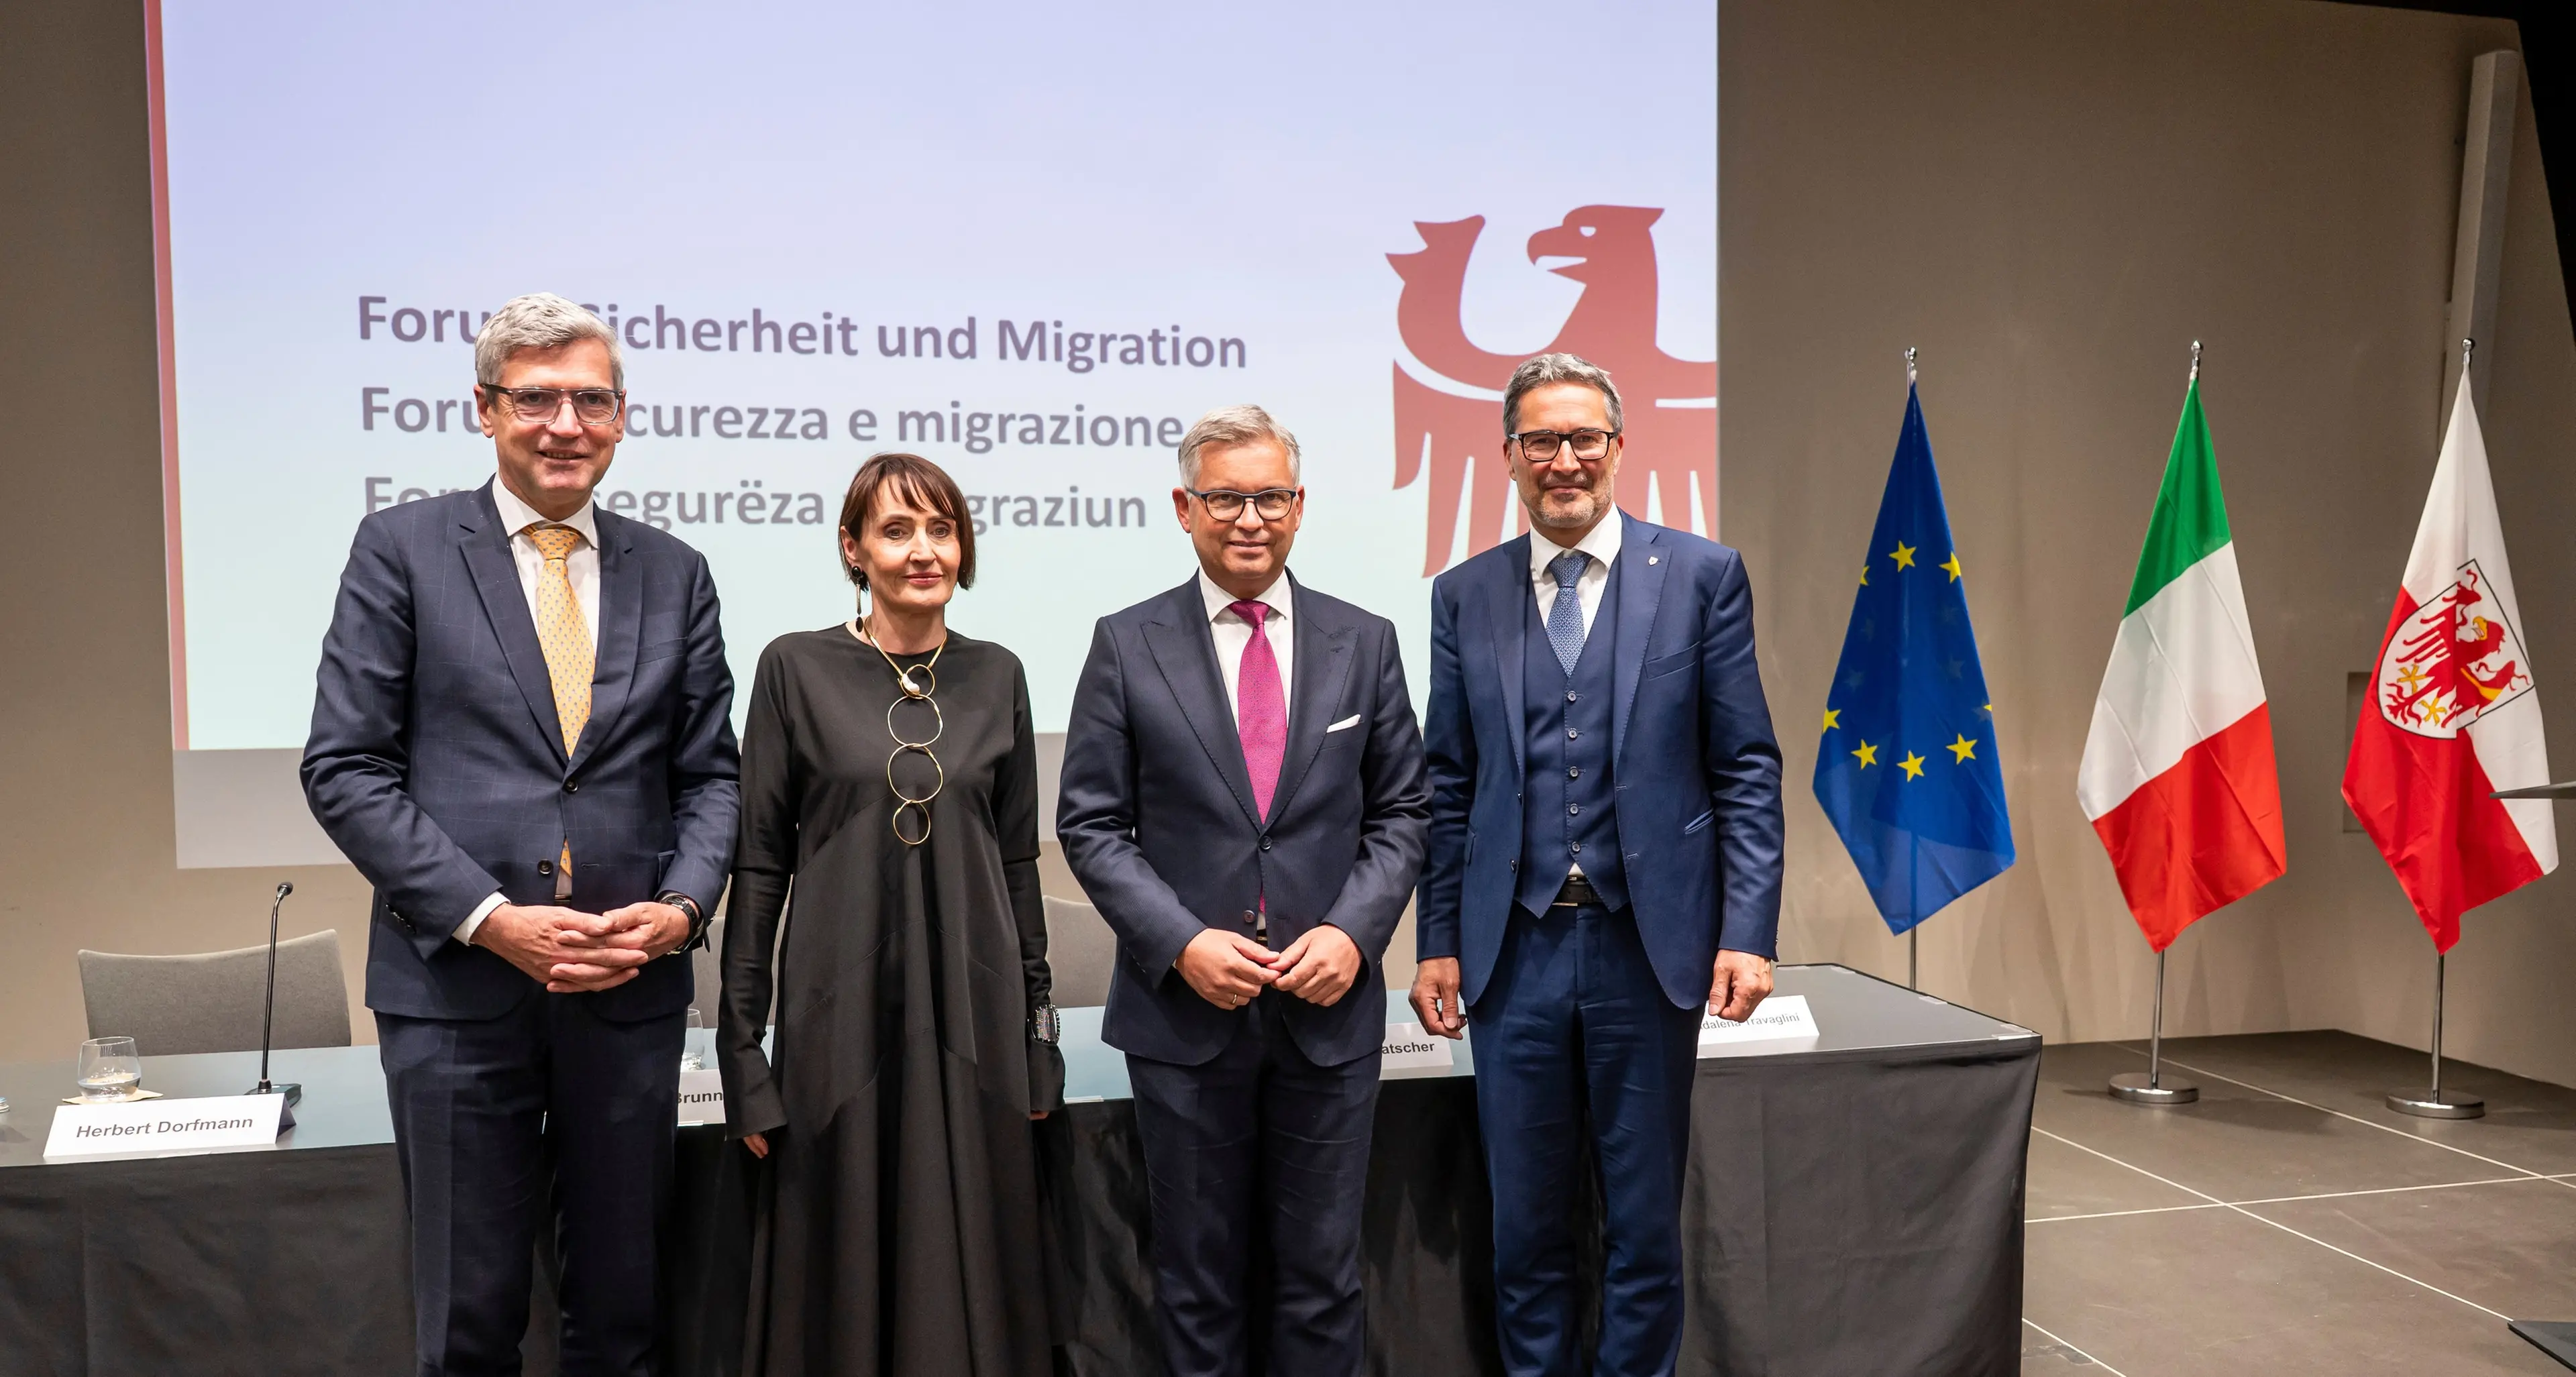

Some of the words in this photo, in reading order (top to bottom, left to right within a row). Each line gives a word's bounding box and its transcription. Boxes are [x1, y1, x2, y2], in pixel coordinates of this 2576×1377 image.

[359, 295, 490, 344] Foru
[579, 302, 859, 356] icherheit
[877, 316, 977, 360] und
[998, 319, 1246, 374] Migration
[362, 386, 481, 433] Foru
[625, 403, 828, 441] curezza
[848, 406, 877, 441] e
[898, 400, 1183, 453] migrazione
[592, 480, 824, 533] egurëza
[964, 485, 1146, 537] graziun
[1700, 1019, 1741, 1030] dalena
[1382, 1042, 1435, 1054] atscher
[678, 1091, 723, 1104] runn
[76, 1123, 152, 1138] Herbert
[157, 1118, 254, 1134] Dorfmann
